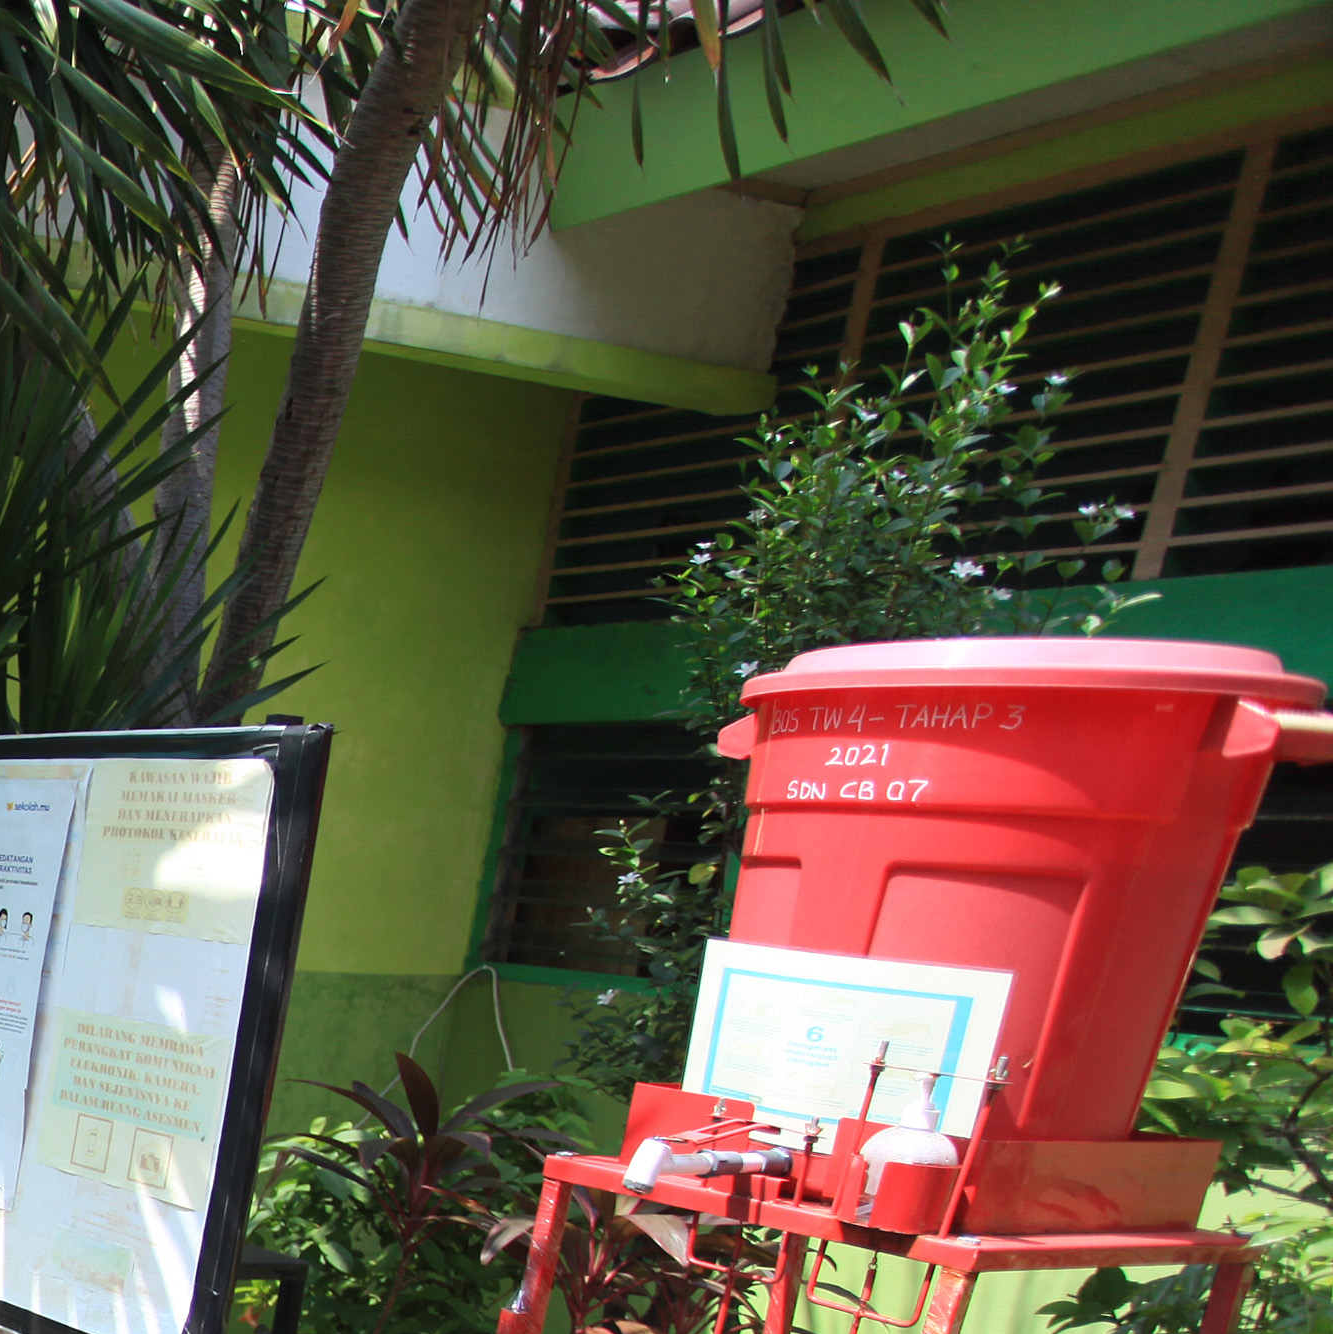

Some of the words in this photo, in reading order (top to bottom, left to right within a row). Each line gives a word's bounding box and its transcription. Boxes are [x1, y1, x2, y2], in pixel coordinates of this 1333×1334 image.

[771, 708, 800, 735] BOS
[895, 703, 994, 729] TAHAP
[999, 704, 1028, 730] 3
[825, 743, 890, 767] 2021
[129, 771, 187, 785] KAWASAN
[121, 790, 179, 803] MEMAKAI
[181, 791, 237, 805] MASKER
[787, 780, 826, 801] SDN
[839, 781, 875, 801] CB
[886, 780, 930, 802] 07
[14, 802, 51, 812] sekolah.mu
[117, 808, 141, 821] DAN
[144, 809, 232, 824] MENERAPKAN
[102, 826, 166, 840] PROTOKOL
[169, 829, 244, 846] KESEHATAN
[77, 1023, 136, 1043] DILARANG
[141, 1034, 204, 1057] MEMBAWA
[806, 1026, 824, 1042] 6
[63, 1037, 133, 1061] PERANGKAT
[135, 1052, 215, 1079] KOMUNIKASI
[787, 1057, 830, 1068] tangan
[73, 1075, 96, 1089] DAN
[99, 1081, 169, 1107] SEJENISNYA
[173, 1097, 190, 1111] KE
[60, 1089, 98, 1108] DALAM
[101, 1100, 141, 1118] RUANG
[143, 1109, 201, 1133] ASESMEN
